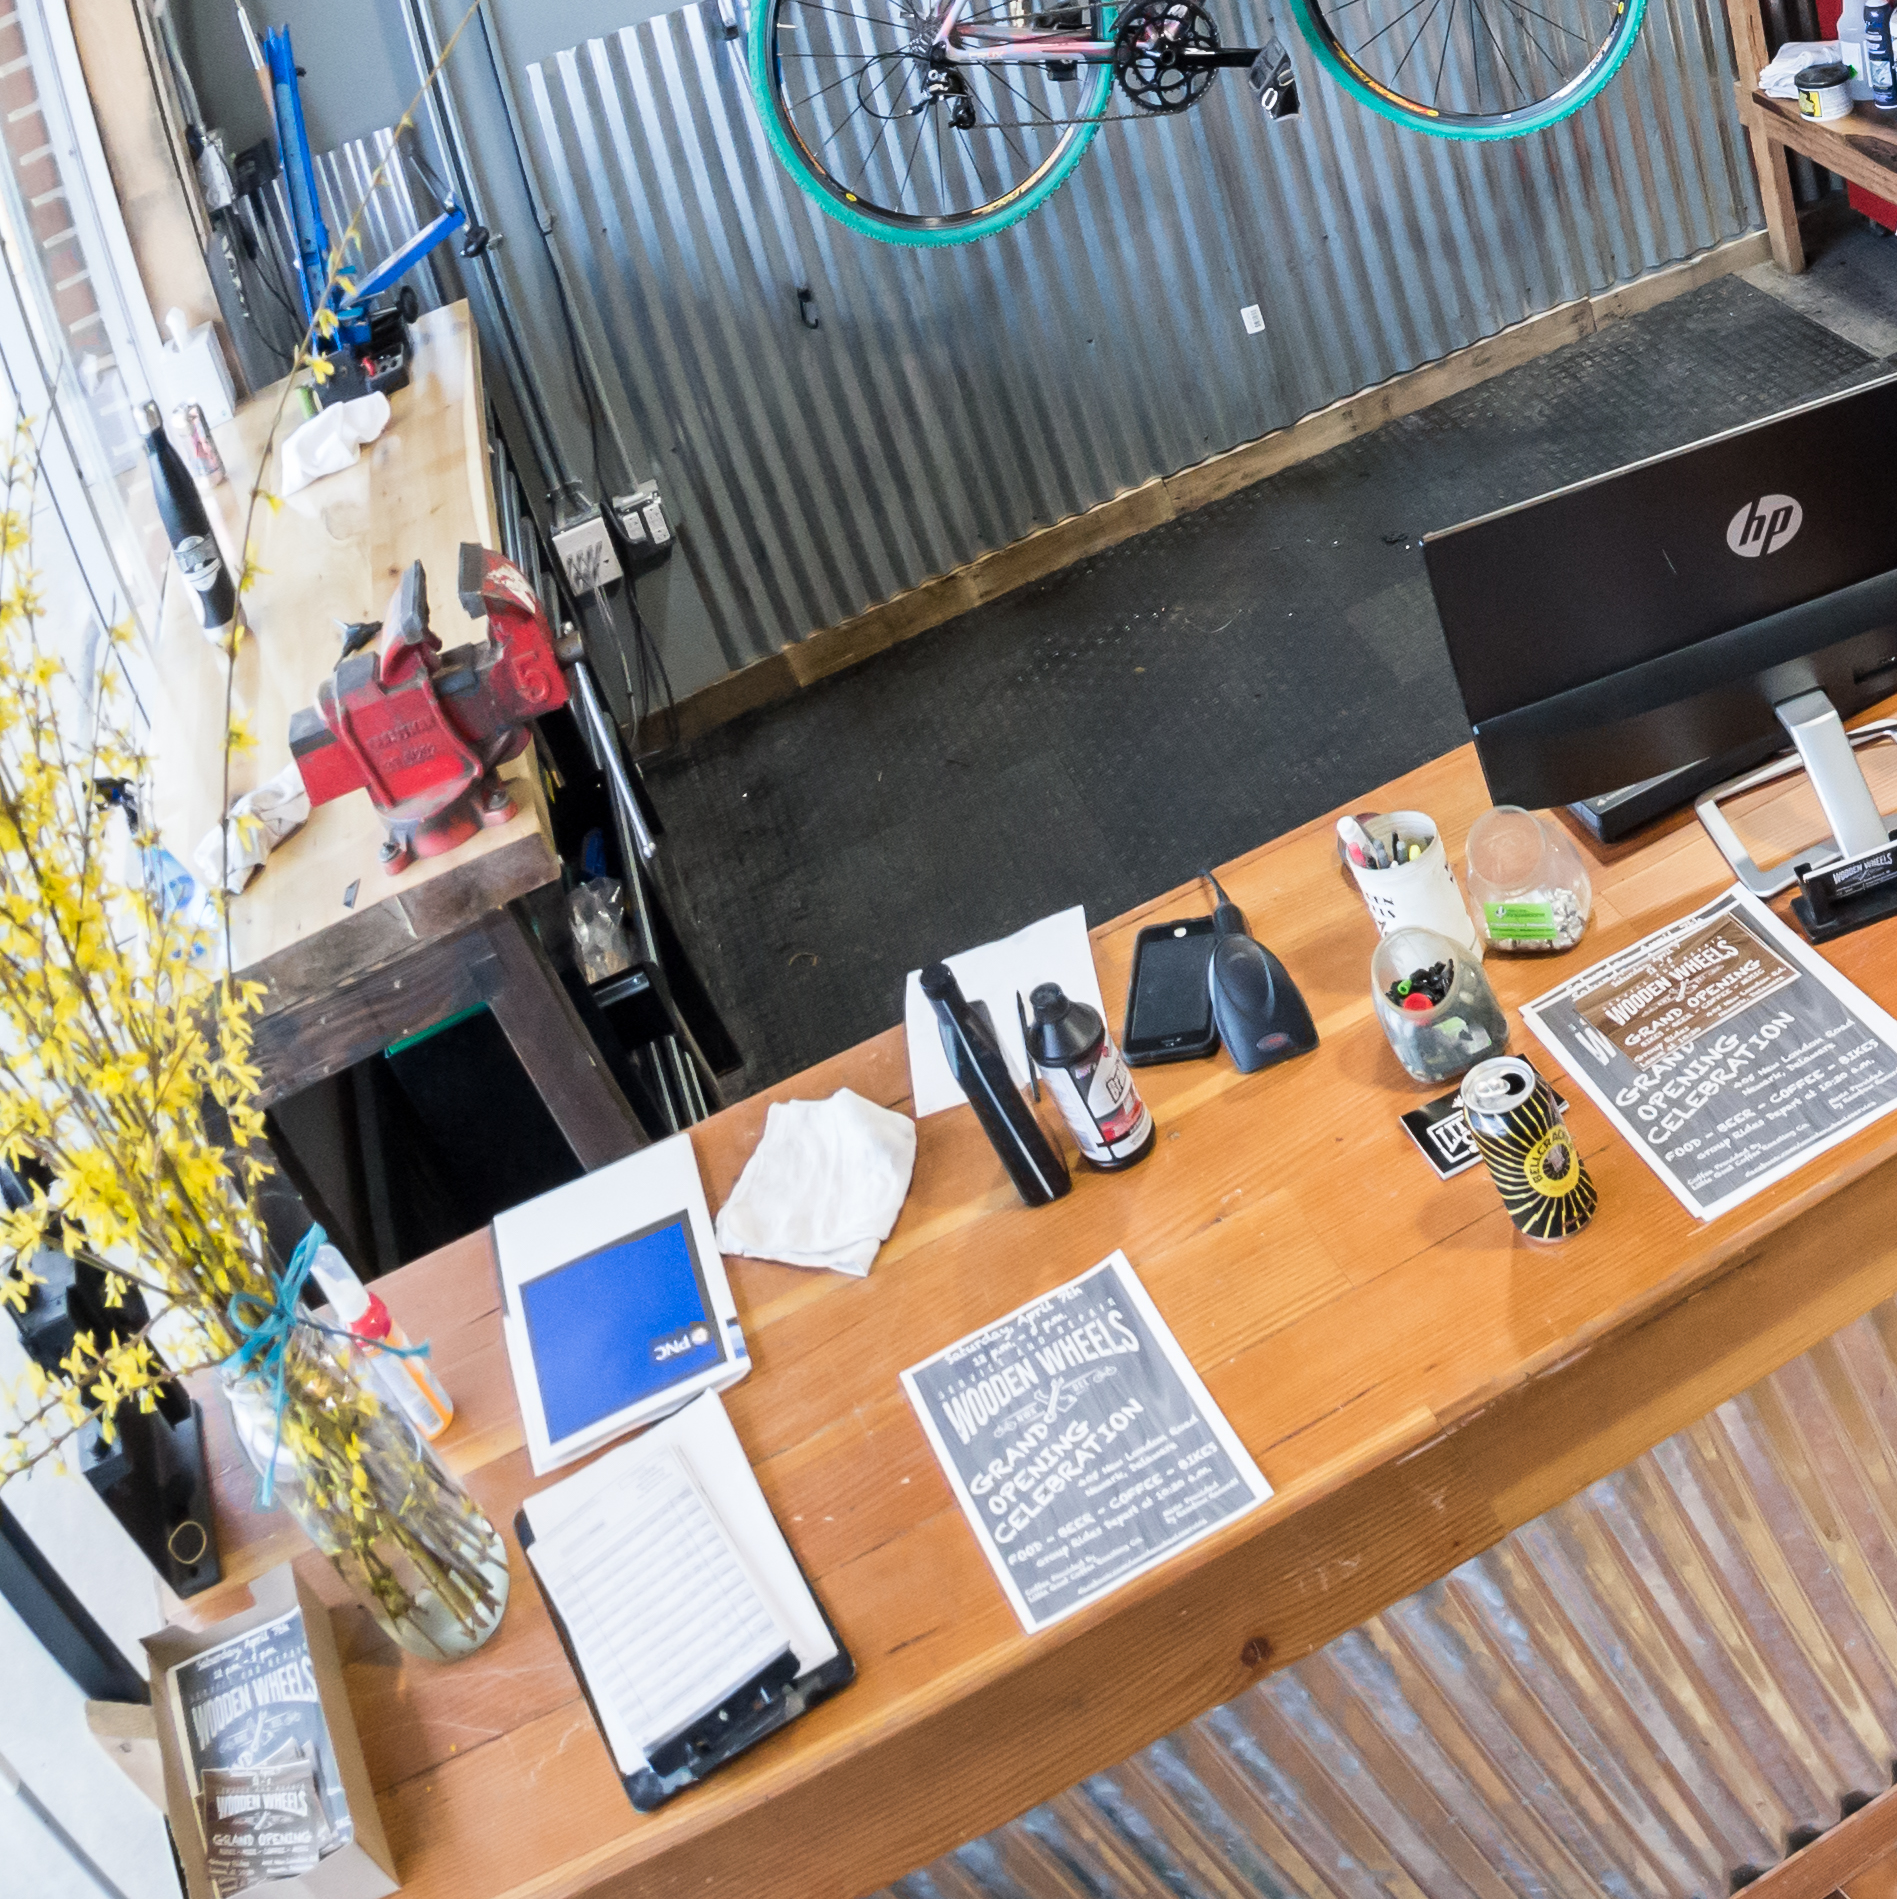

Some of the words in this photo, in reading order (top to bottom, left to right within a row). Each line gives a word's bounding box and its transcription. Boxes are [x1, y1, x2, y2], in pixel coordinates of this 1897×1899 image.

[1738, 494, 1795, 557] hp
[1832, 863, 1863, 885] WOODEN
[1863, 852, 1893, 869] WHEELS
[1602, 976, 1678, 1027] WOODEN
[1666, 939, 1739, 989] WHEELS
[1624, 1007, 1683, 1046] GRAND
[1686, 959, 1762, 1008] OPENING
[1700, 988, 1733, 1010] COFFEE
[1616, 1041, 1696, 1106] GRAND
[1741, 1071, 1786, 1097] Newark,
[1786, 1042, 1836, 1072] Delaware
[1780, 1037, 1825, 1063] London
[1824, 1018, 1856, 1039] Road
[1638, 1033, 1740, 1120] OPENING
[1648, 1011, 1796, 1145] CELEBRATION
[1665, 1139, 1702, 1163] FOOD
[1716, 1108, 1757, 1133] BEER
[1769, 1068, 1825, 1104] COFFEE
[1838, 1038, 1879, 1065] BIKES
[1731, 1119, 1765, 1140] Rides
[1766, 1097, 1803, 1121] Depart
[1804, 1089, 1818, 1100] at
[654, 1334, 691, 1361] PNC
[942, 1320, 1015, 1366] Saturday,
[1013, 1299, 1056, 1329] April
[941, 1357, 1039, 1446] WOODEN
[1035, 1308, 1140, 1377] WHEELS
[969, 1422, 1048, 1495] GRAND
[989, 1419, 1090, 1515] OPENING
[994, 1397, 1144, 1544] CELEBRATION
[1008, 1541, 1043, 1566] FOOD
[1057, 1512, 1096, 1538] BEER
[1109, 1472, 1164, 1510] COFFEE
[1177, 1441, 1218, 1470] BIKES
[1141, 1497, 1154, 1509] at
[192, 1683, 252, 1750] WOODEN
[252, 1656, 319, 1706] WHEELS
[212, 1833, 254, 1847] GRAND
[258, 1830, 312, 1846] OPENING
[217, 1794, 261, 1820] WOODEN
[263, 1790, 308, 1818] WHEELS
